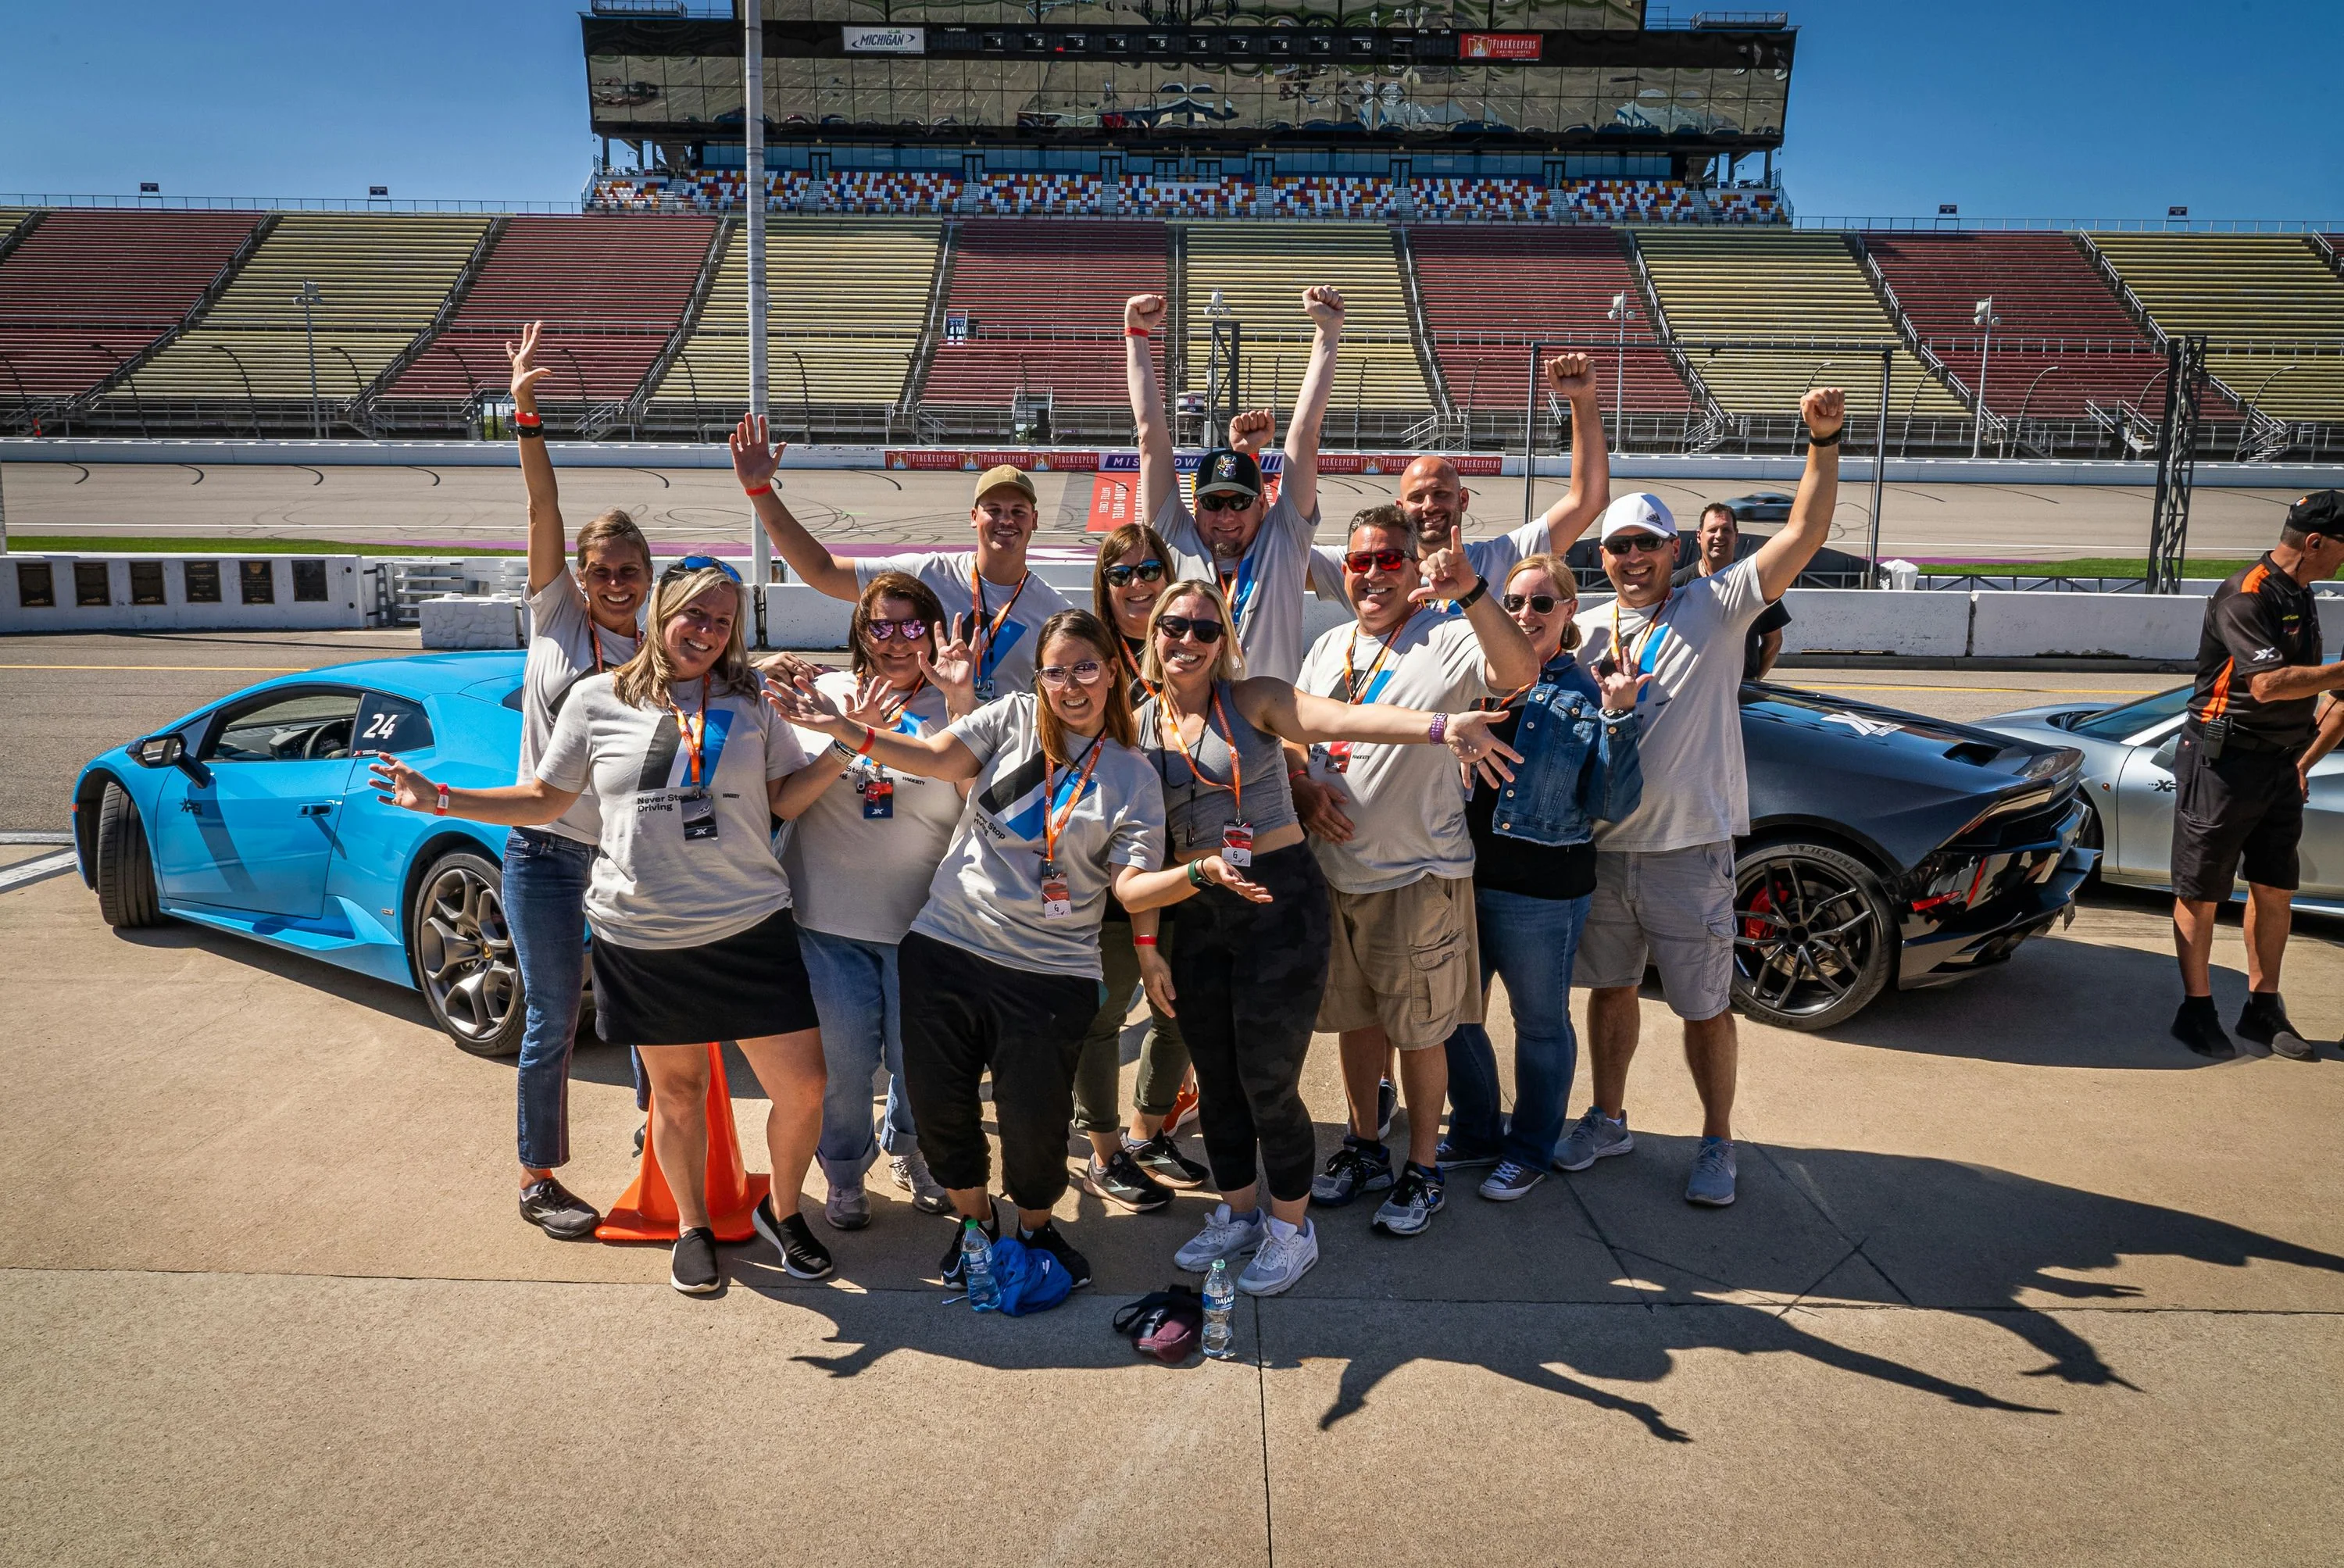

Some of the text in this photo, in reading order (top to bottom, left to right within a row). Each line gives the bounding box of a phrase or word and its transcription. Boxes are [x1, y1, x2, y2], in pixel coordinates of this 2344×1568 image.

[859, 34, 904, 46] MICHIGAN
[1077, 38, 1084, 47] 3
[1159, 39, 1166, 48] 5
[912, 453, 956, 463] FIREKEEPERS
[984, 454, 1027, 463] FIREKEEPERS
[1054, 455, 1098, 464] FIREKEEPERS
[1113, 457, 1139, 466] MIS
[1318, 457, 1358, 466] IREKEEPERS
[1457, 459, 1500, 469] FIREKEEPERS
[1112, 503, 1125, 519] HOTEL
[363, 713, 399, 740] 24
[902, 776, 926, 786] HAGERTY
[637, 795, 665, 805] Never
[638, 802, 674, 813] Driving
[974, 818, 989, 836] riving
[988, 822, 1006, 840] Stop
[1215, 1294, 1235, 1305] DASAN
